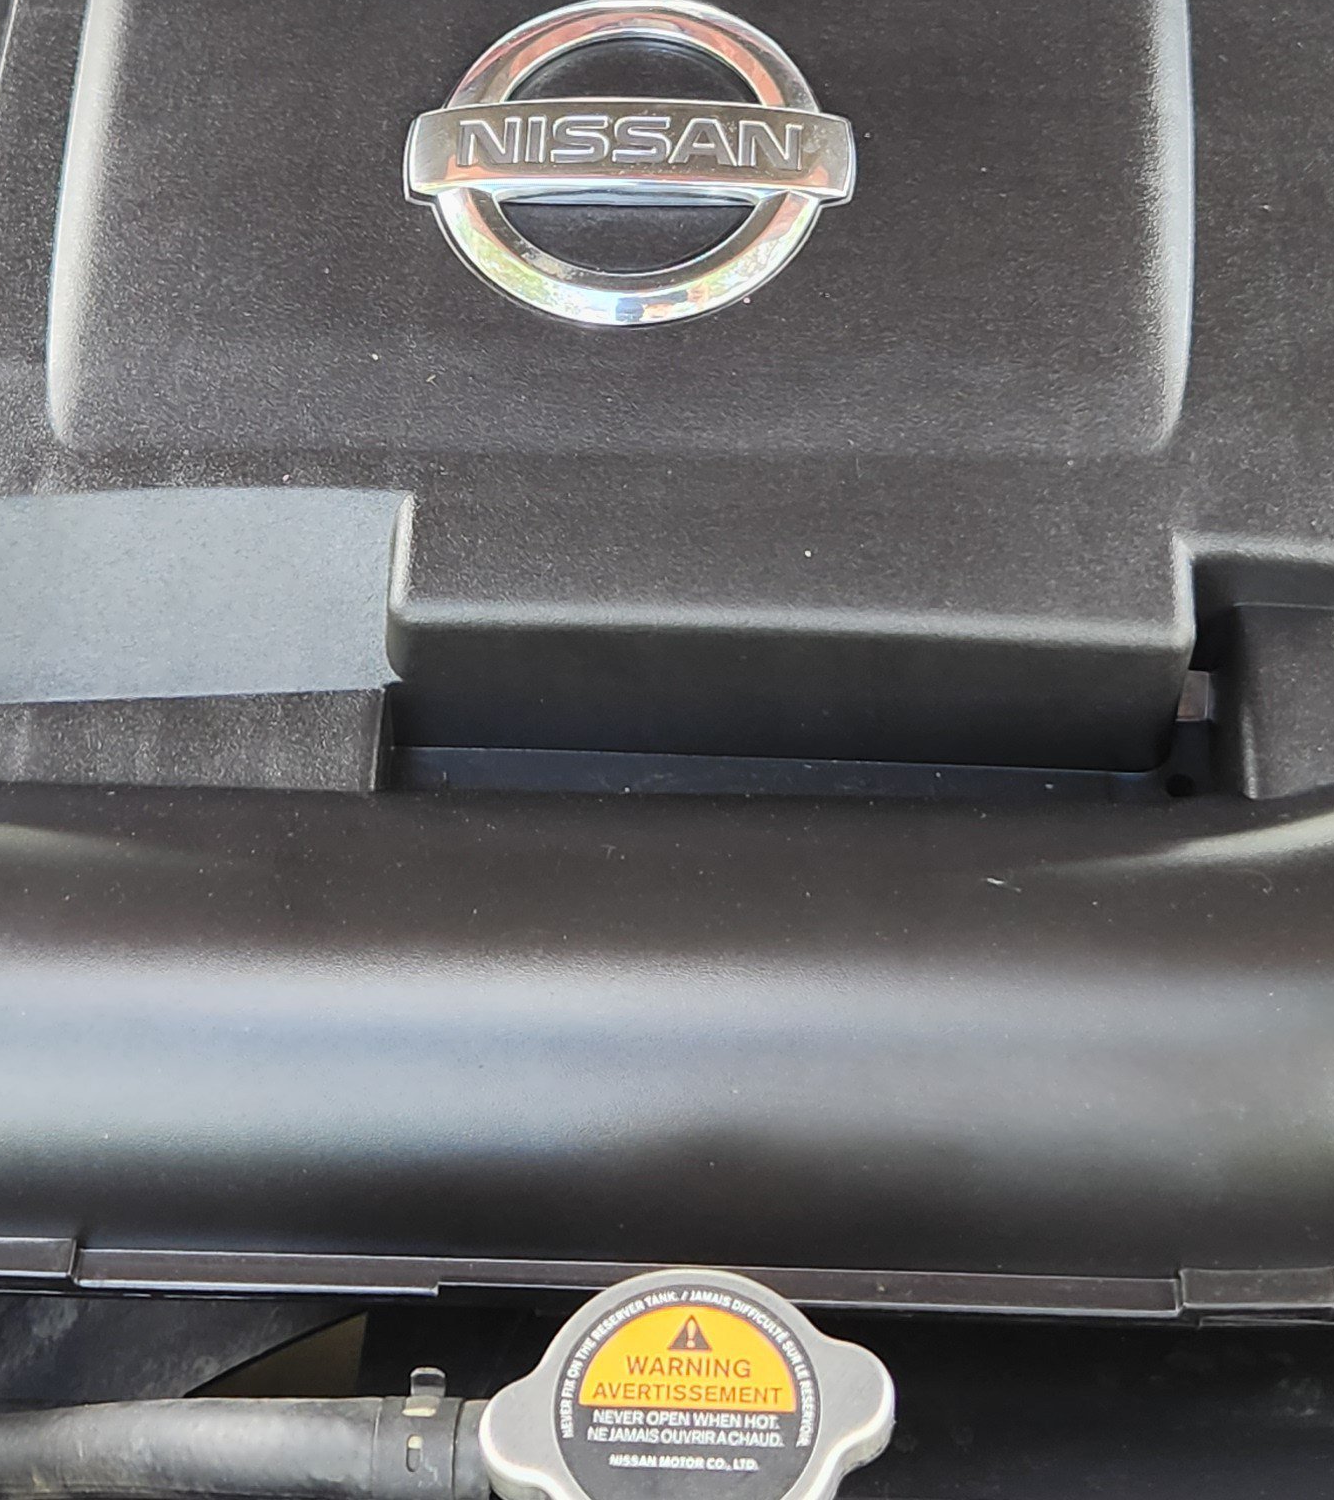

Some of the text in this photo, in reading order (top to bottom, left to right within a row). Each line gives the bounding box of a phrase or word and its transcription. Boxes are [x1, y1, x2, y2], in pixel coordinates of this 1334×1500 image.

[455, 114, 805, 172] NISSAN
[690, 1289, 732, 1307] JAMAIS
[590, 1299, 646, 1341] RESERVER
[575, 1337, 597, 1360] THE
[782, 1340, 804, 1366] SUR
[567, 1359, 584, 1379] ON
[626, 1355, 752, 1379] WARNING
[794, 1363, 811, 1380] LE
[592, 1381, 783, 1405] AVERTISSEMENT
[560, 1399, 575, 1439] NEVER
[593, 1408, 781, 1430] NEVER OPEN WHEN HOT.
[587, 1426, 609, 1442] NE
[608, 1427, 660, 1444] JAMAIS
[660, 1428, 717, 1446] OUVRIR
[728, 1430, 785, 1448] CHAUD.
[608, 1453, 657, 1468] NISSAN
[658, 1455, 705, 1470] MOTOR
[733, 1457, 760, 1472] LTD.
